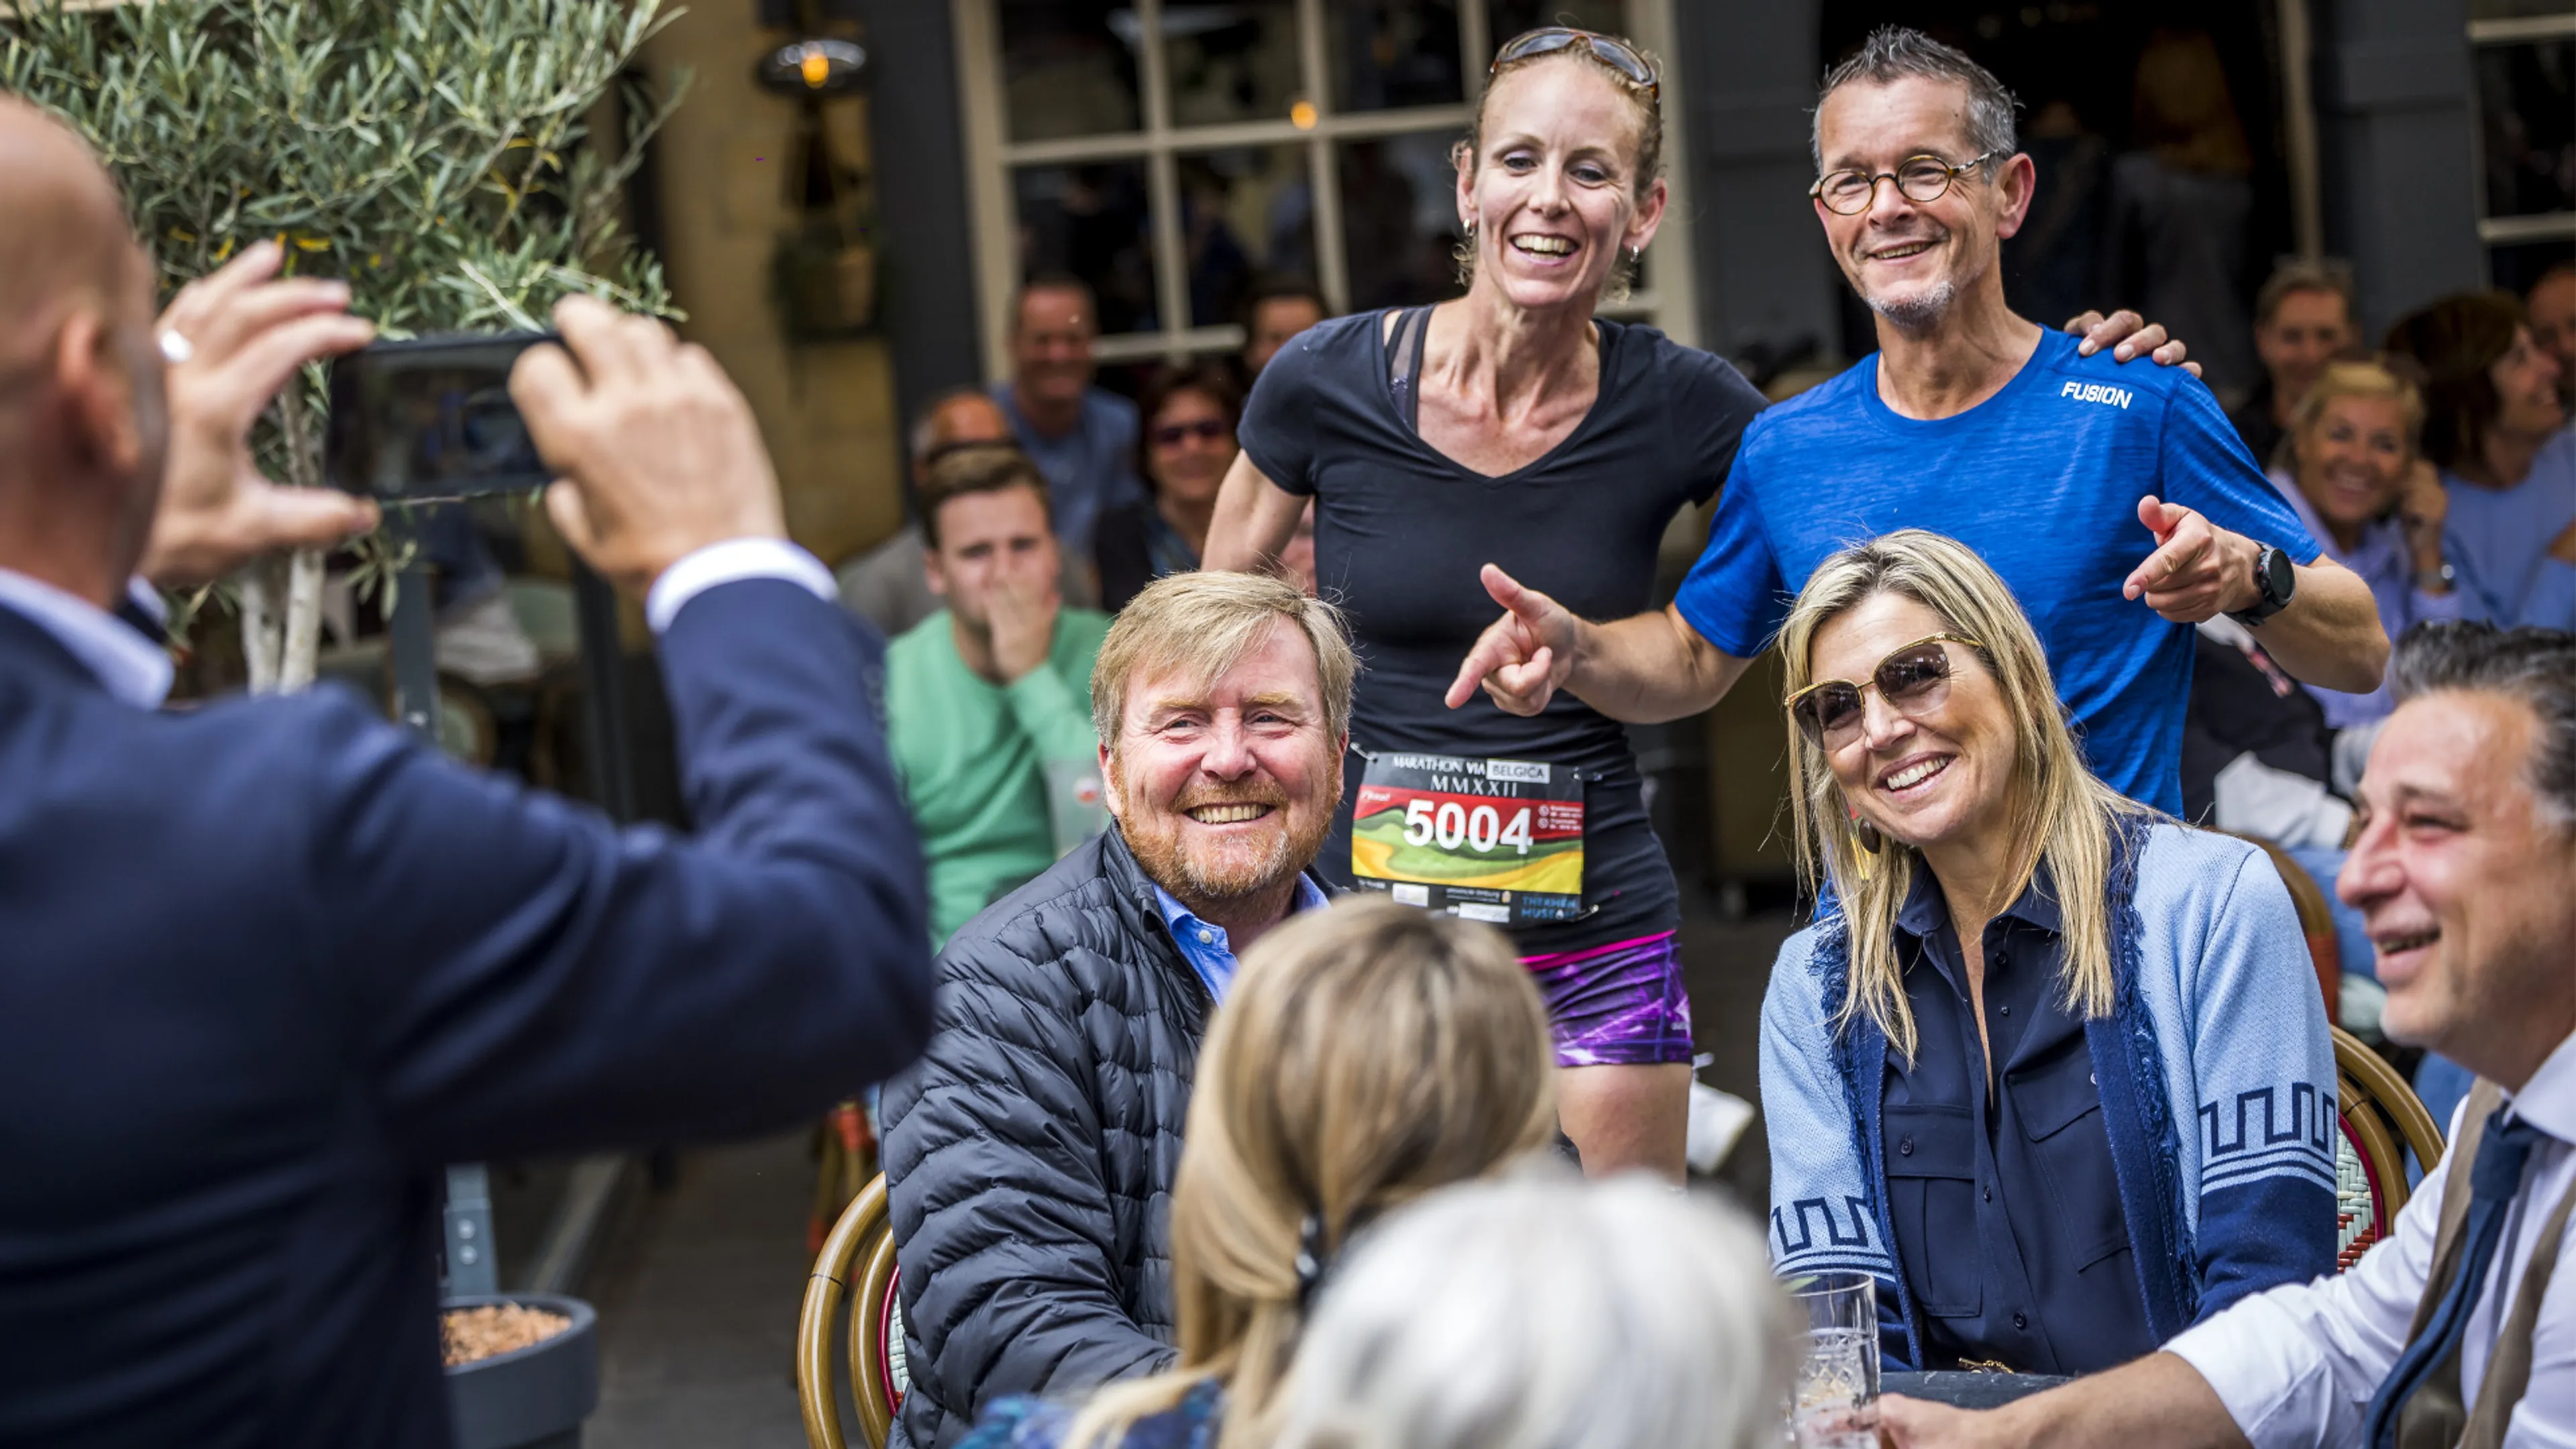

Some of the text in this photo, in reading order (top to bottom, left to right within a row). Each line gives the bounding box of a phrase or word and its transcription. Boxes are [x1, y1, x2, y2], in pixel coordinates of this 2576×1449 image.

[2061, 381, 2133, 410] FUSION
[1393, 755, 1544, 779] MARATHON VIA BELGICA
[1430, 774, 1518, 798] MMXXII
[1403, 798, 1534, 855] 5004
